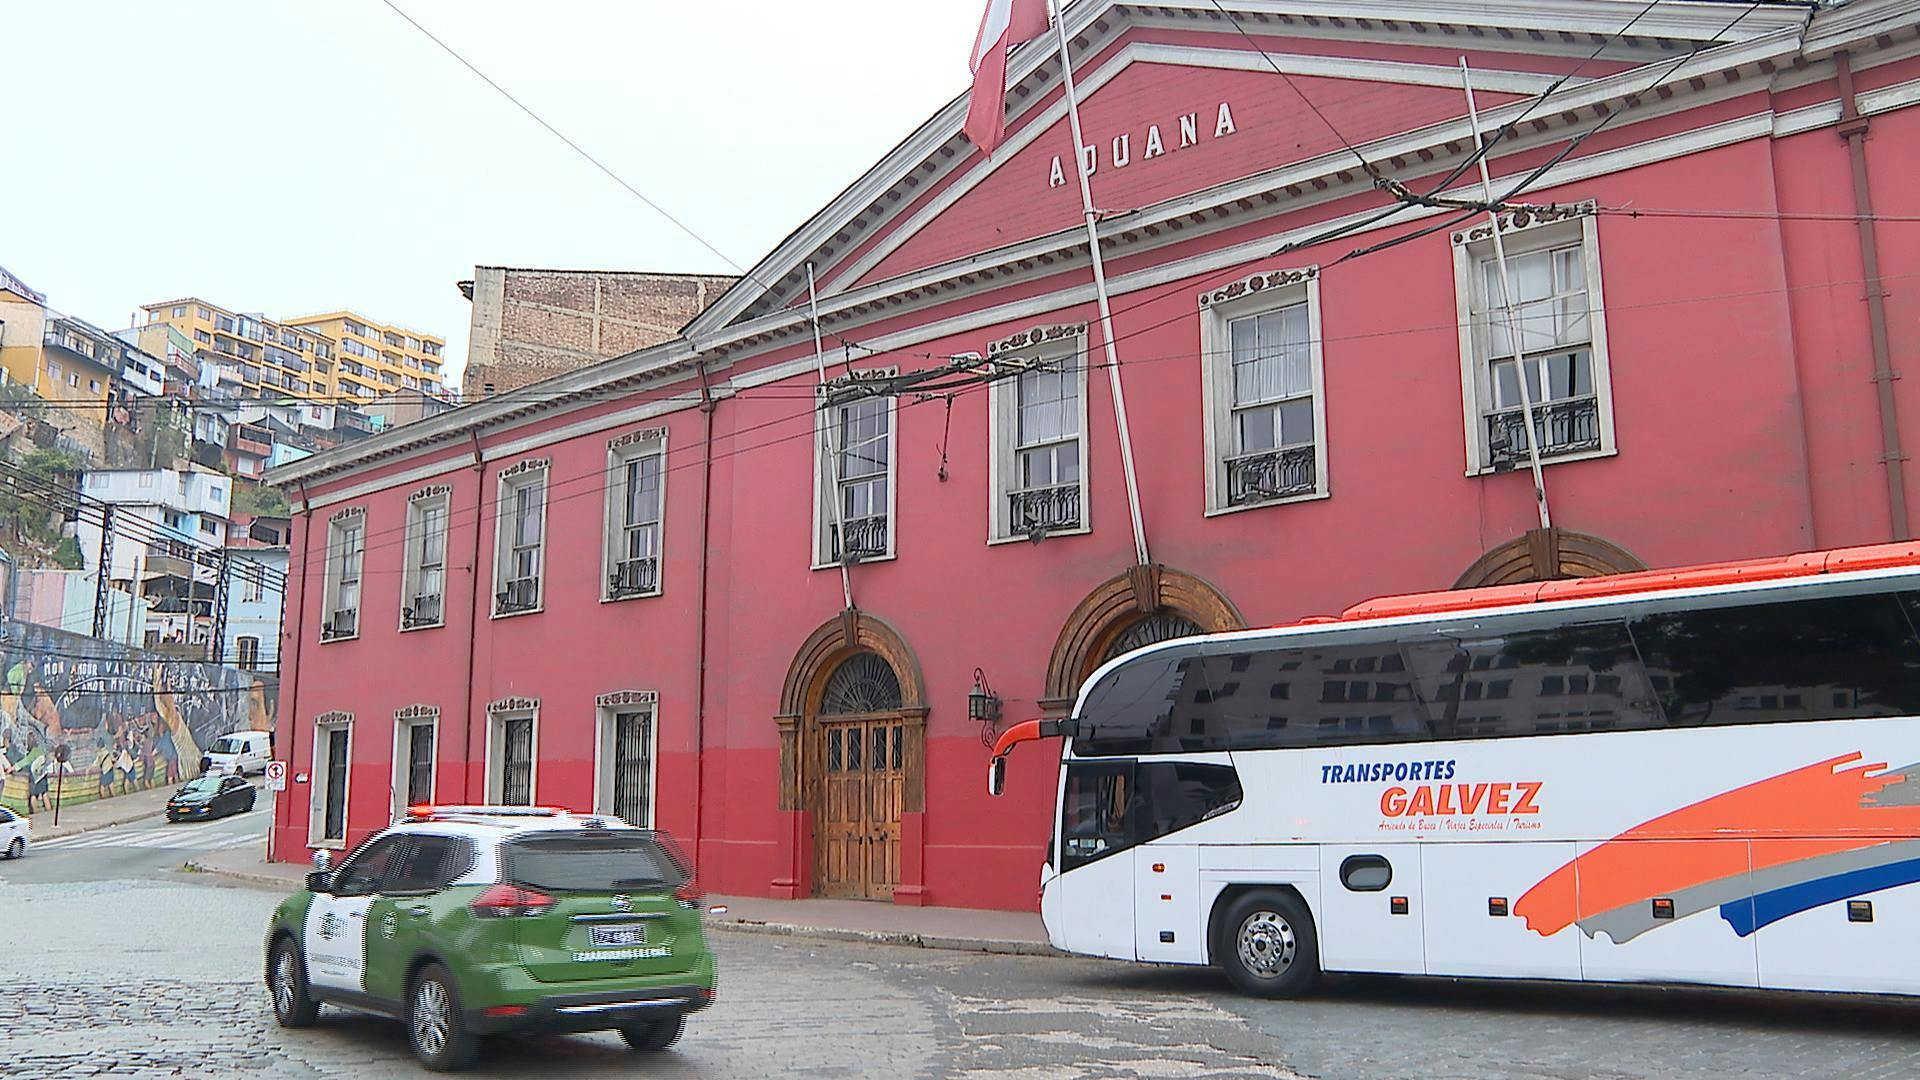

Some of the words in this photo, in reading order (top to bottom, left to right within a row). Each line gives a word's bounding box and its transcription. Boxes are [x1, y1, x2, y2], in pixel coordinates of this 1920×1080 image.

[1050, 102, 1237, 188] ADUANA
[44, 661, 64, 676] MON
[71, 663, 98, 677] AMOUR
[111, 679, 124, 692] MY
[1321, 760, 1456, 784] TRANSPORTES
[1380, 781, 1543, 818] GALVEZ
[1408, 820, 1415, 830] de
[1418, 819, 1436, 830] Buses
[1446, 818, 1466, 832] Viajes
[1469, 818, 1503, 832] Especiales
[1513, 818, 1543, 830] Turismo
